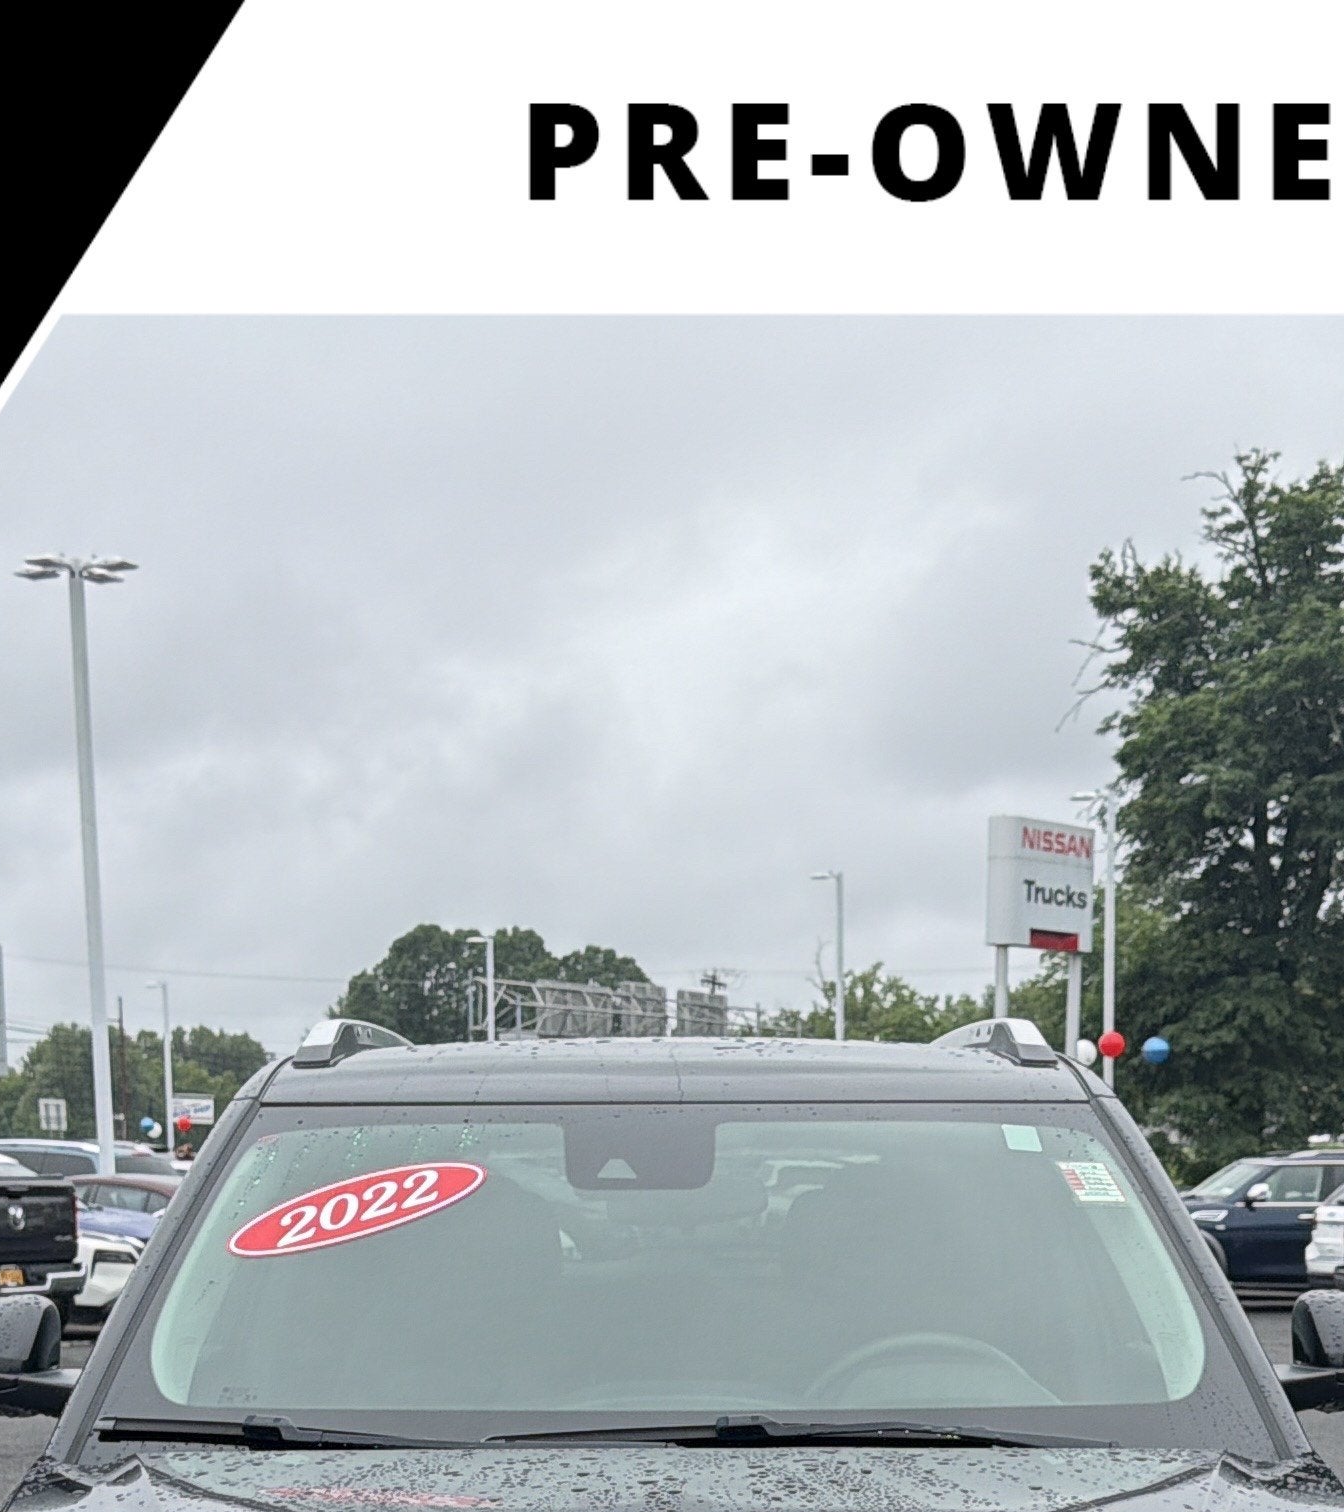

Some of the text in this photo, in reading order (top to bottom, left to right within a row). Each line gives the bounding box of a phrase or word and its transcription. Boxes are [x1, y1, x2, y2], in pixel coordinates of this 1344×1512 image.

[1021, 826, 1092, 859] NISSAN
[1023, 879, 1087, 909] Trucks
[276, 1169, 439, 1248] 2022
